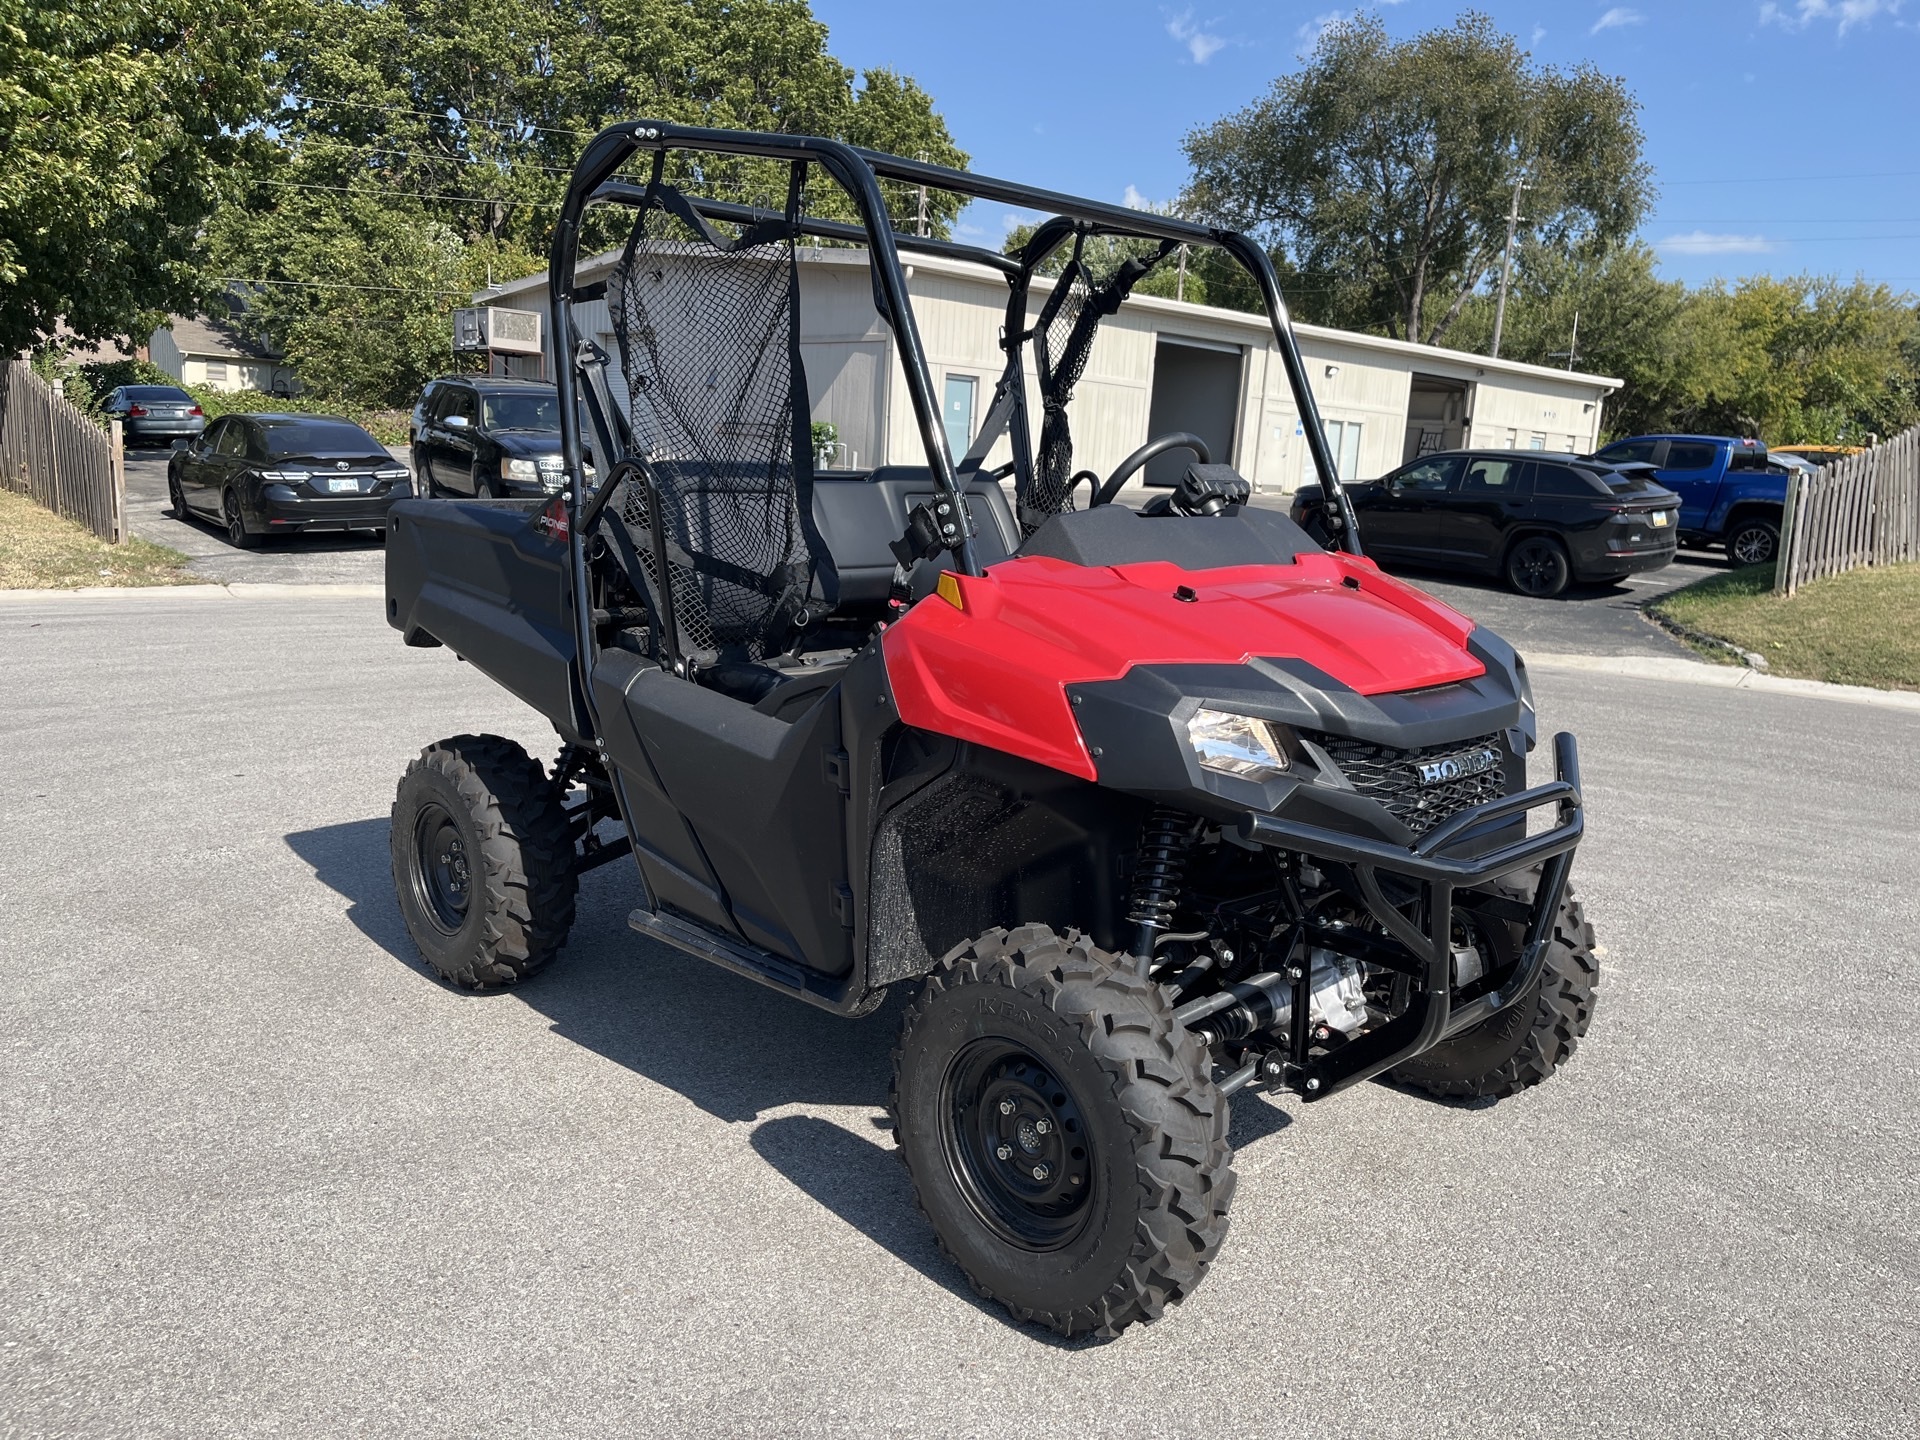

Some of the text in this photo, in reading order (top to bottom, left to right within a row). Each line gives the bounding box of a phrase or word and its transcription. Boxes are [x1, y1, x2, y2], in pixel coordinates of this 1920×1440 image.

[540, 516, 568, 532] PIONE
[1420, 750, 1494, 785] HONDA
[978, 997, 1074, 1065] KENDA
[1498, 993, 1529, 1042] NDA
